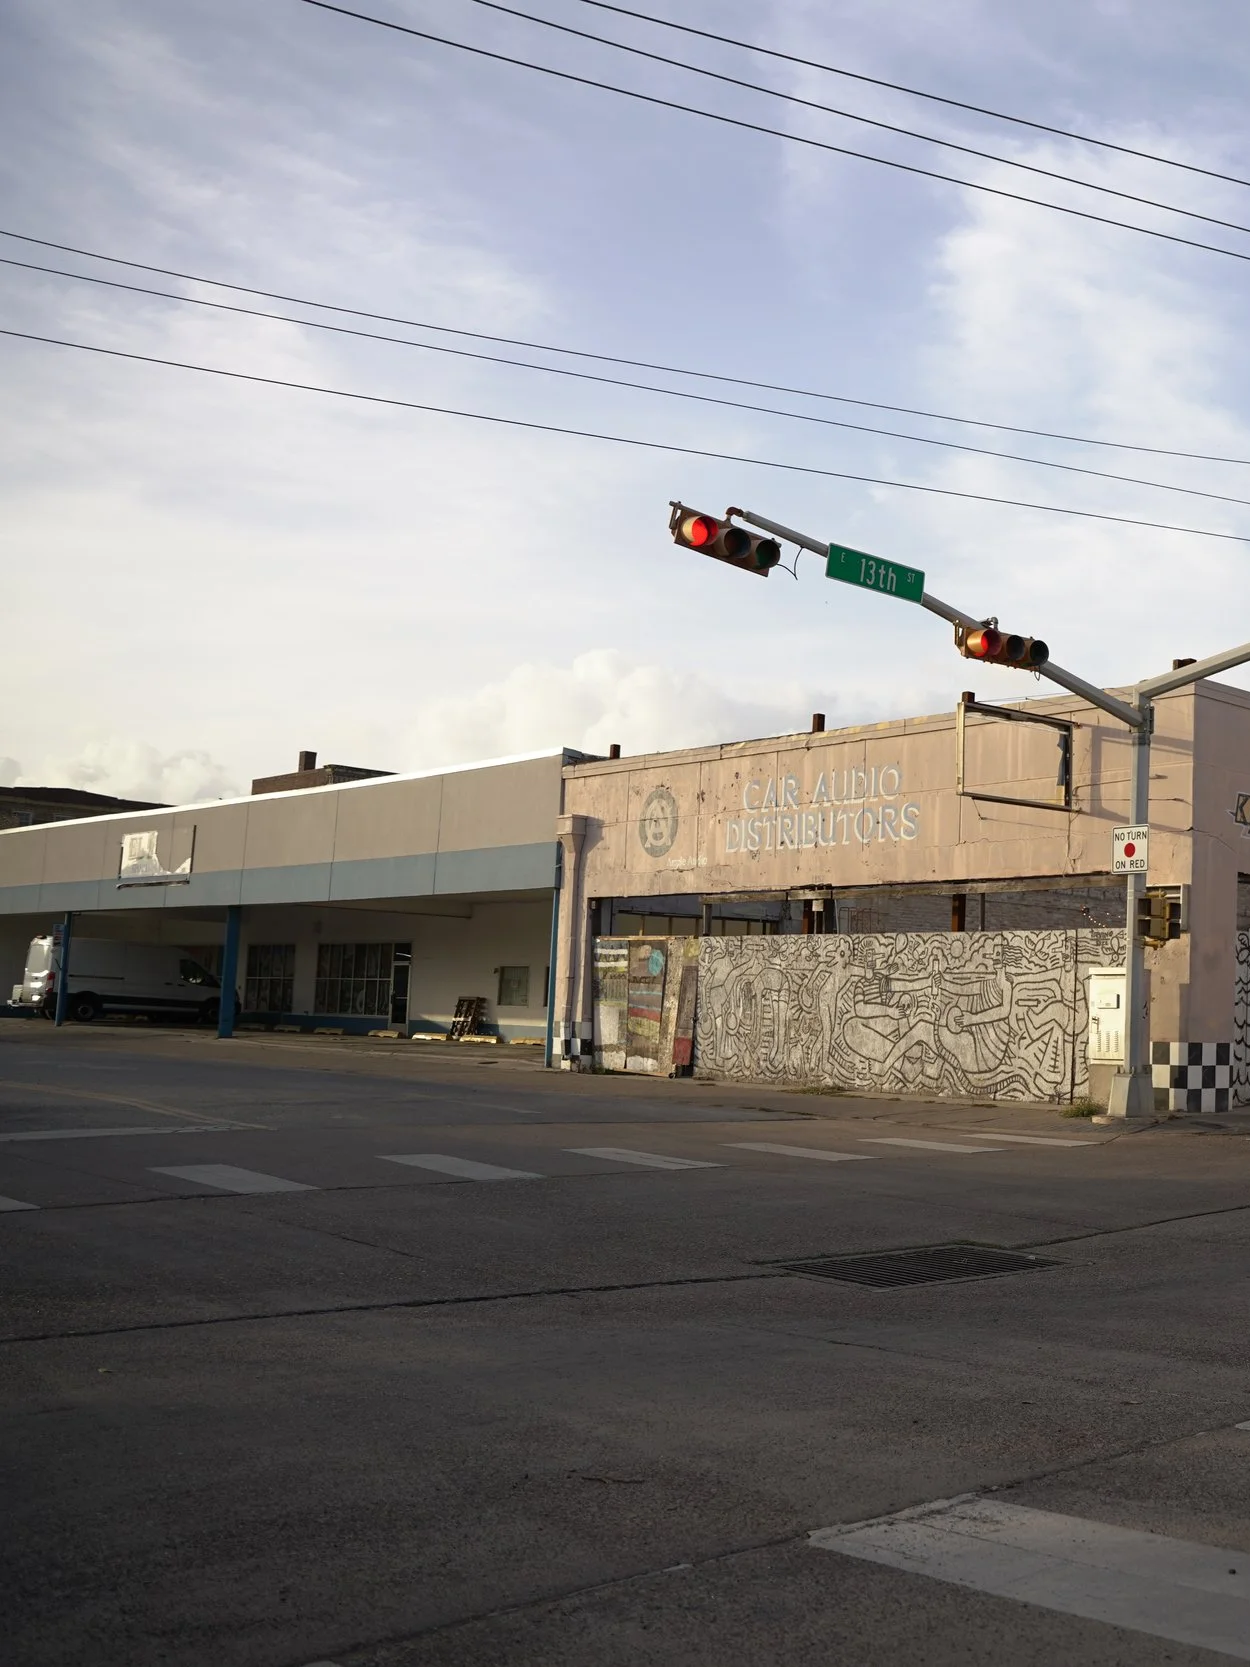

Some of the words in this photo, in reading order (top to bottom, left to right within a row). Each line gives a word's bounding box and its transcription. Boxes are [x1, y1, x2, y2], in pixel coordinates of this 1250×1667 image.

[841, 552, 846, 563] E
[860, 558, 897, 592] 13th
[906, 572, 916, 584] ST
[743, 775, 800, 814] CAR
[809, 765, 902, 808] AUDIO
[726, 801, 920, 853] DISTRIBUTORS
[1115, 832, 1125, 841] NO
[1127, 831, 1147, 840] TURN
[1115, 861, 1126, 869] ON
[1130, 859, 1145, 869] RED
